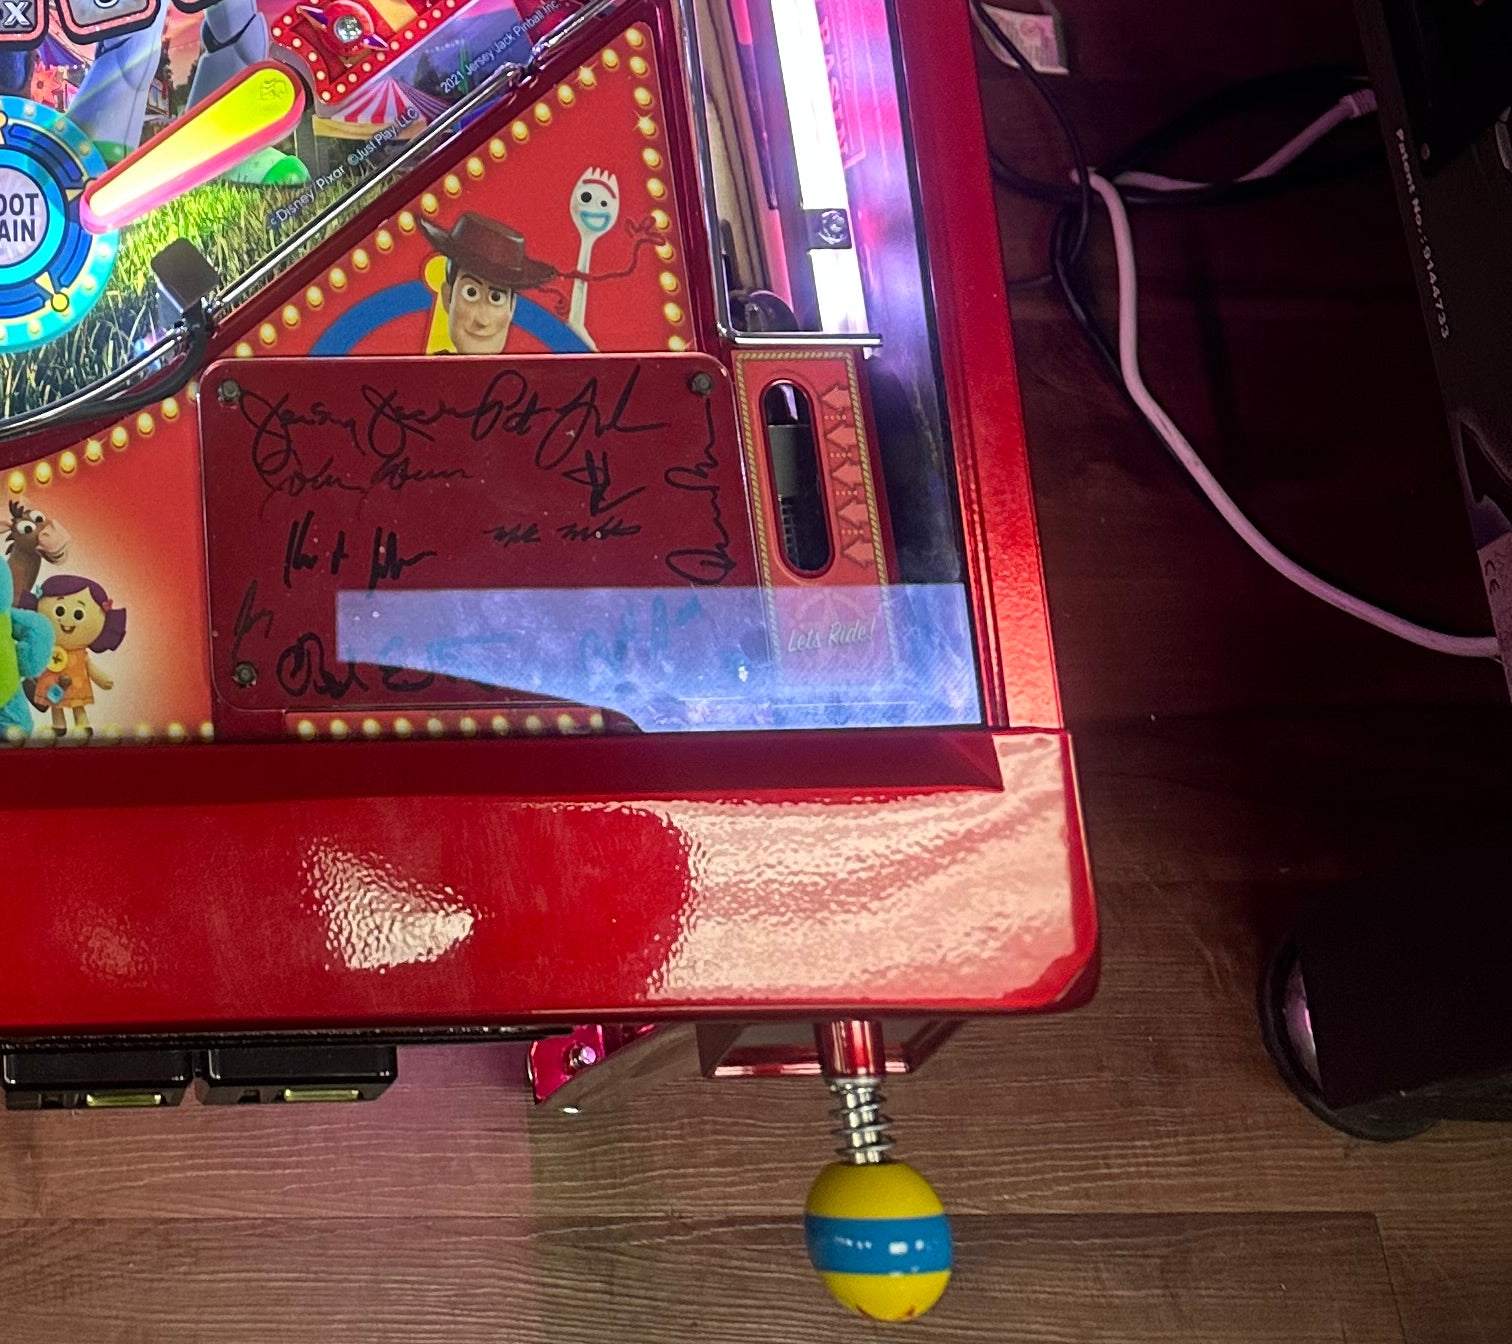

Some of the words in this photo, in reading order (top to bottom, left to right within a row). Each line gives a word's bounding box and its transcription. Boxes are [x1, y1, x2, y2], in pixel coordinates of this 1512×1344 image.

[439, 64, 466, 94] 2021
[462, 43, 496, 80] Jersey
[492, 31, 516, 58] Jack
[511, 9, 546, 43] Pinball
[787, 628, 822, 653] Lets
[828, 616, 877, 647] Ride!
